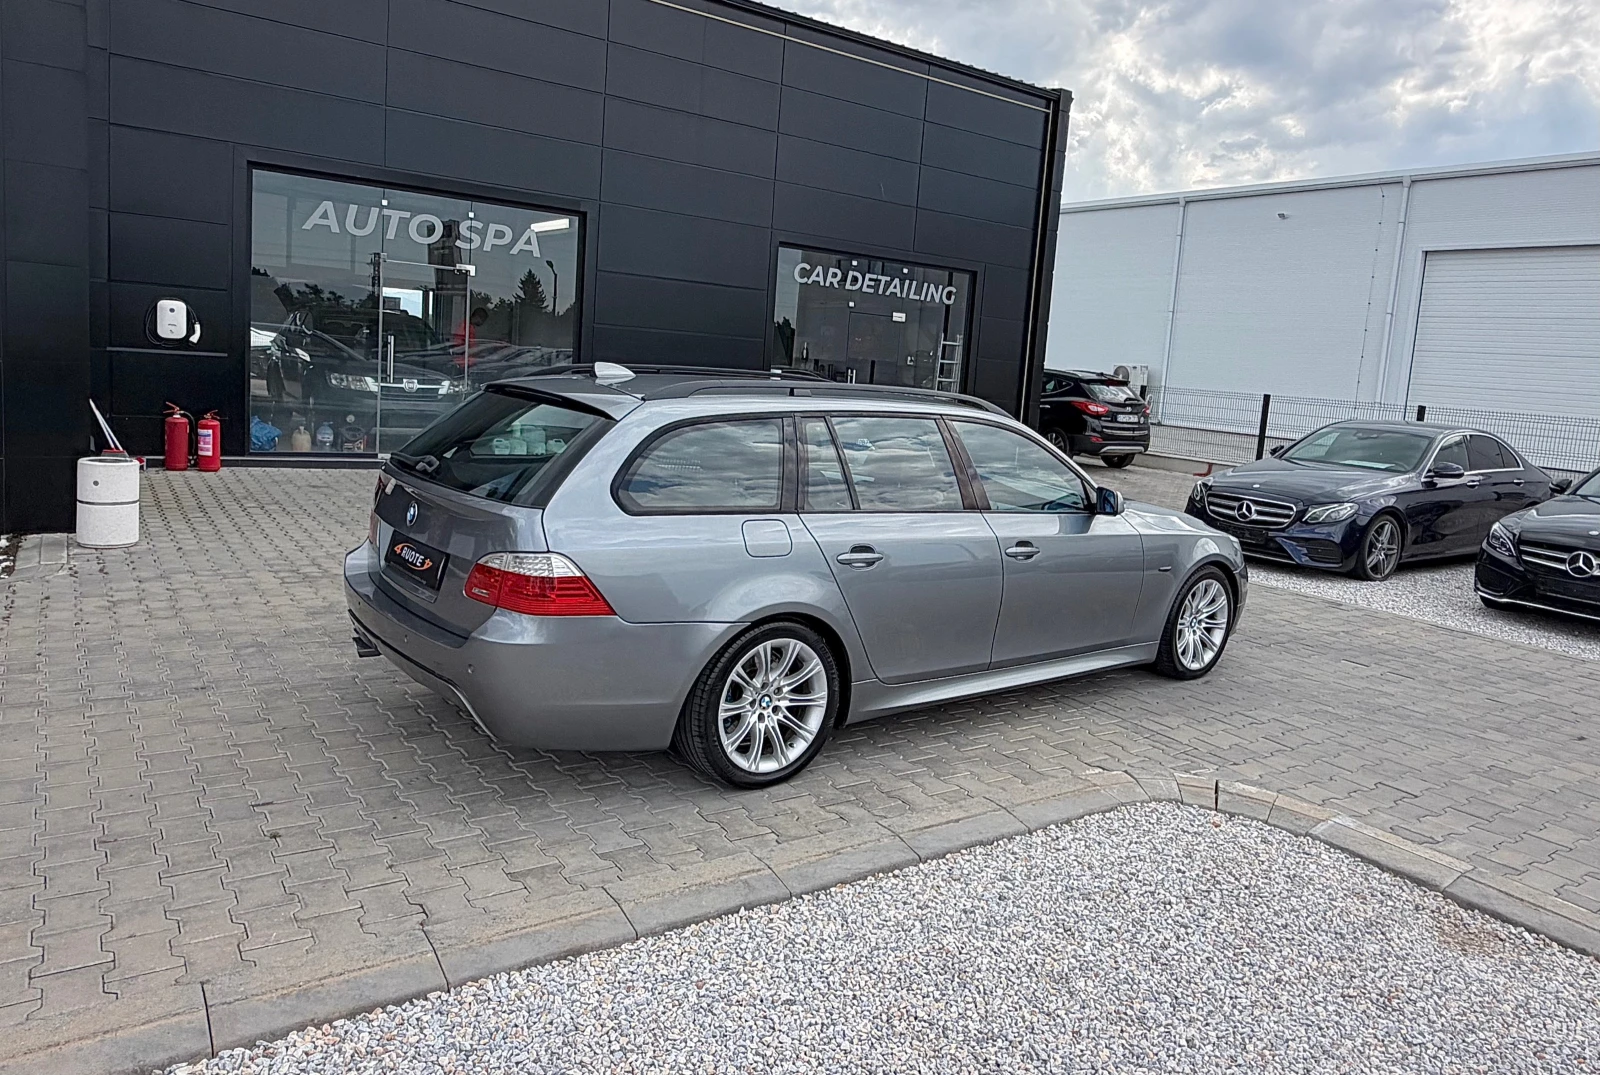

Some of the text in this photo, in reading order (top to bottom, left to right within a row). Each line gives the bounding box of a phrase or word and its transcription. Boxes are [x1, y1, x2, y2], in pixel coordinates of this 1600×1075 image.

[302, 201, 541, 258] AUTO SPA
[794, 263, 957, 305] CAR DETAILING
[401, 547, 424, 566] RUOTE
